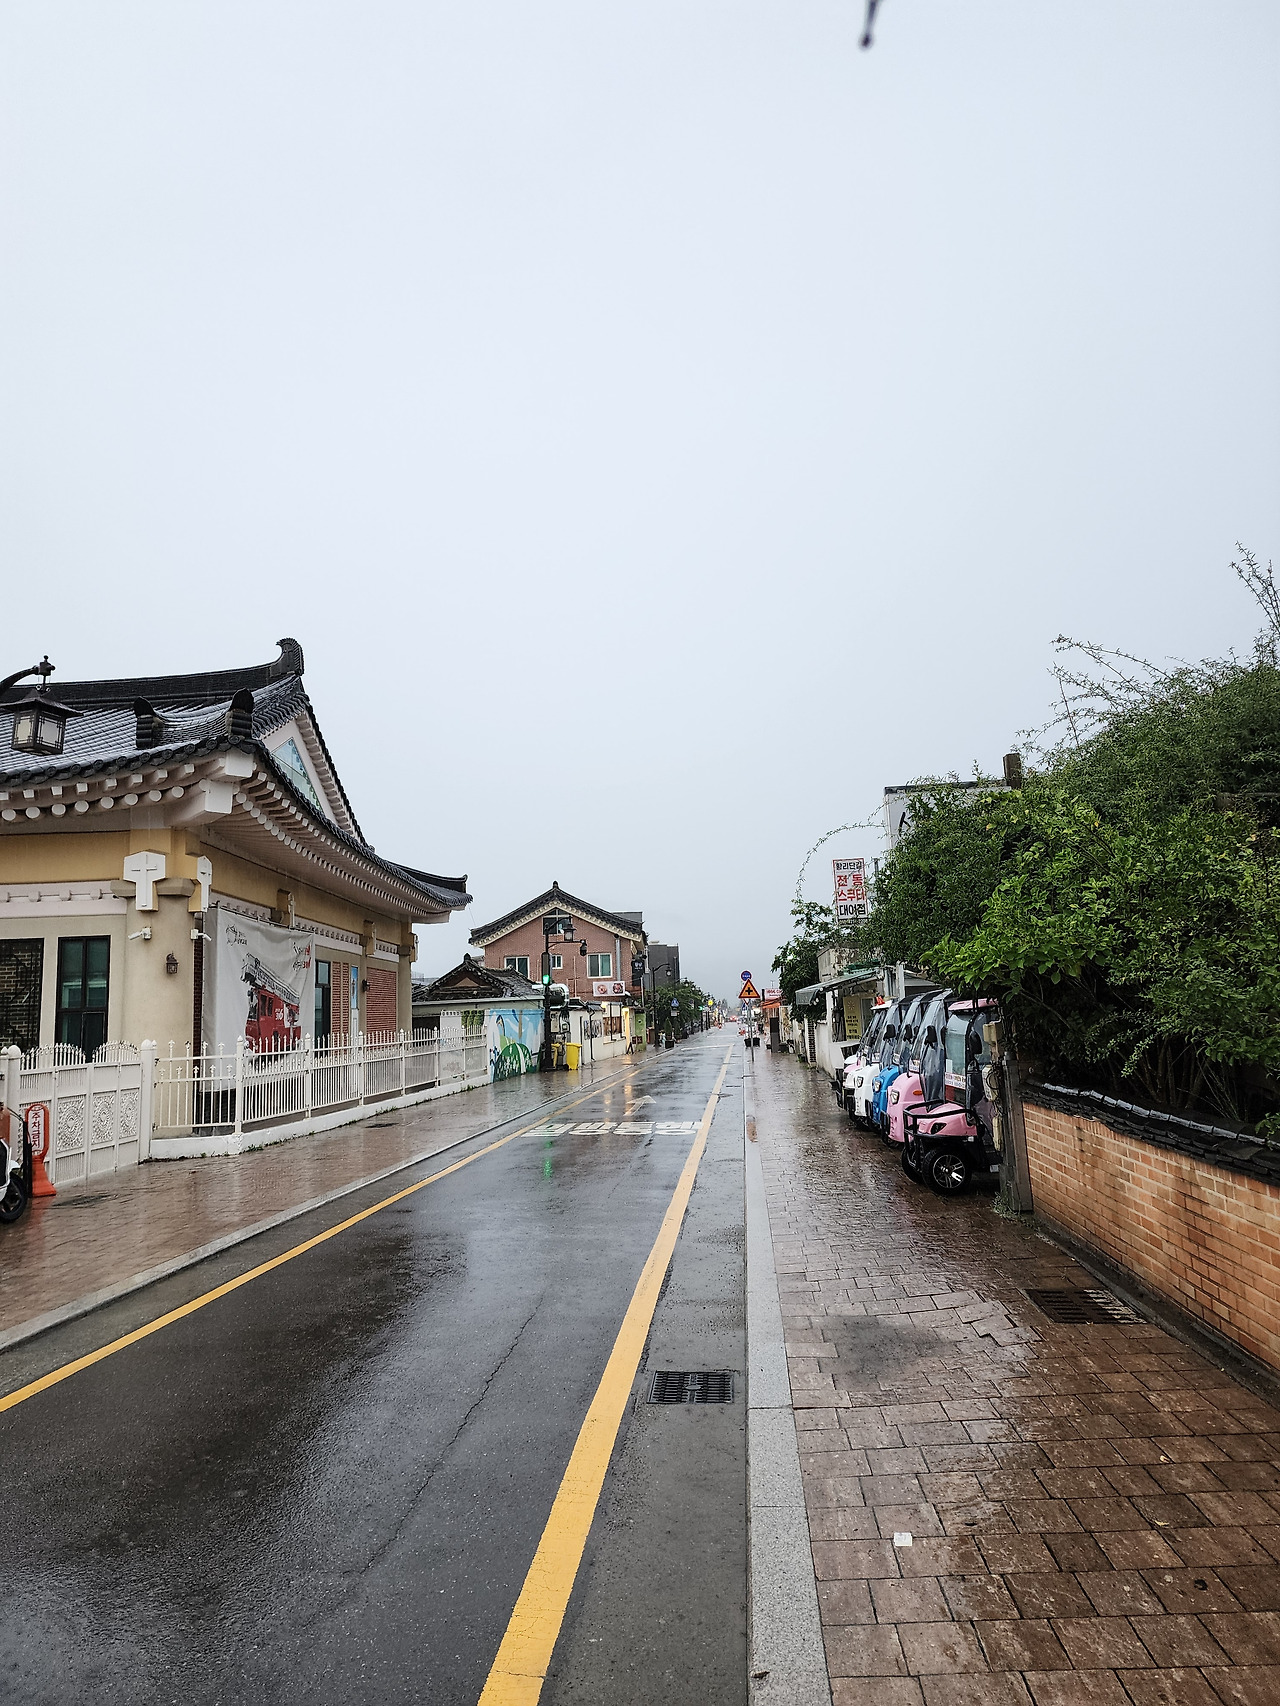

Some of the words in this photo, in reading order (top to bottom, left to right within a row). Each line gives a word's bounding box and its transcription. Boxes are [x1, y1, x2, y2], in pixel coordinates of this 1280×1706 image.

[838, 889, 865, 901] 스쿠터
[31, 1112, 41, 1149] 주차금지
[521, 1121, 703, 1137] 일방통행
